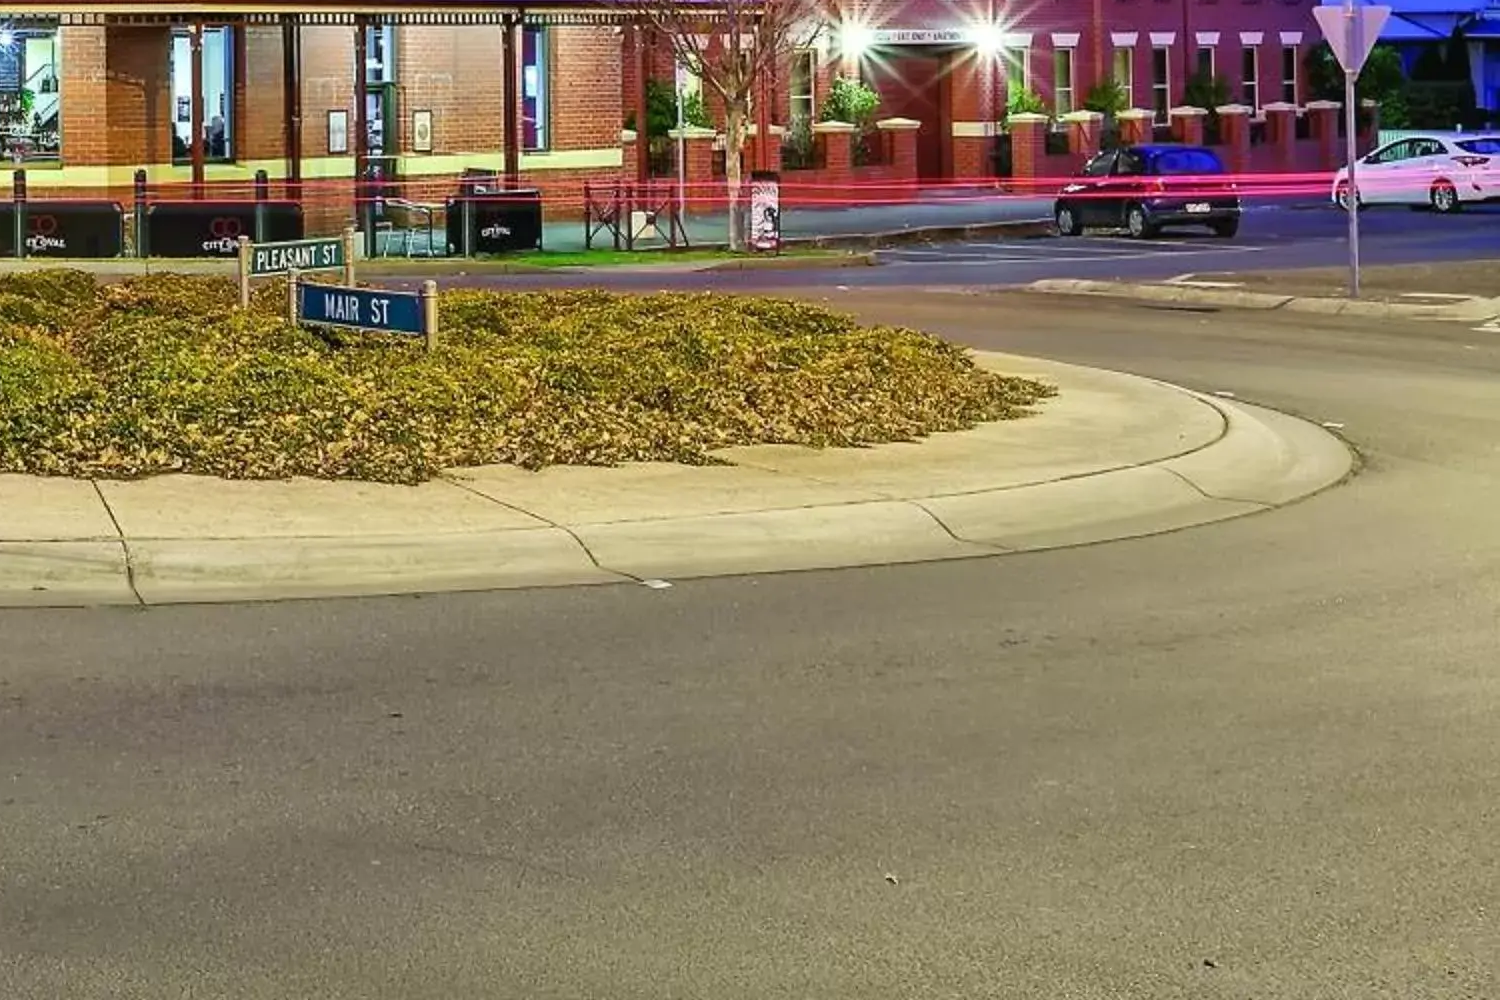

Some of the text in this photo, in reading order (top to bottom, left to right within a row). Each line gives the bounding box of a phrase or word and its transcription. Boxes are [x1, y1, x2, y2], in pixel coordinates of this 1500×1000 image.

[257, 244, 337, 271] PLEASANT ST
[325, 293, 389, 325] MAIR ST
